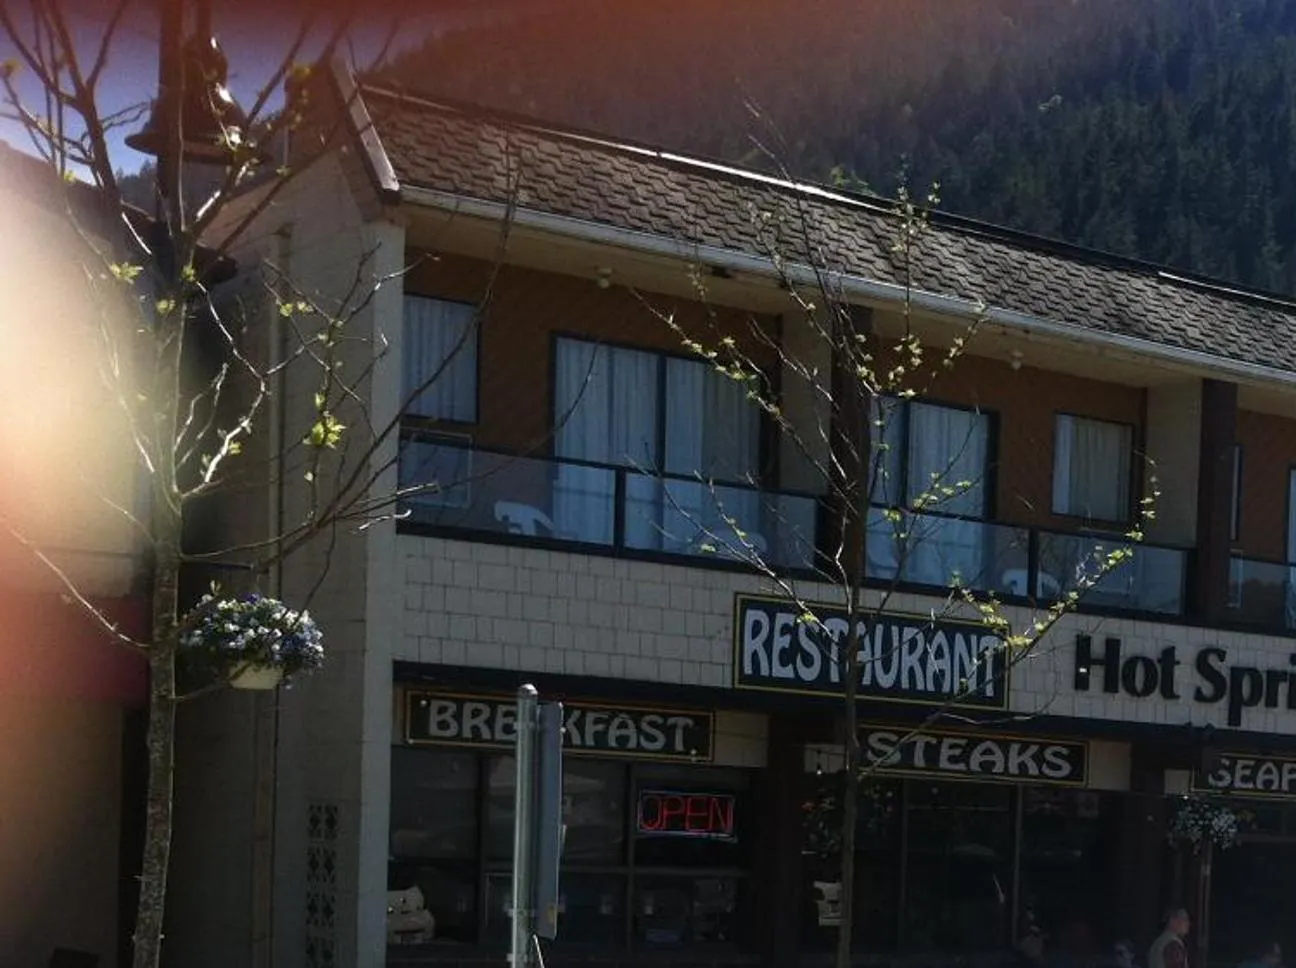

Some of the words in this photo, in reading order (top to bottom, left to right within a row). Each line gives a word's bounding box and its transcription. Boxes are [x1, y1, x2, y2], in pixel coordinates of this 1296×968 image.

[744, 609, 1003, 697] RESTAURANT
[1074, 634, 1180, 700] Hot
[428, 700, 694, 751] BREKFAST
[867, 731, 1072, 778] STEAKS
[641, 795, 734, 834] OPEN
